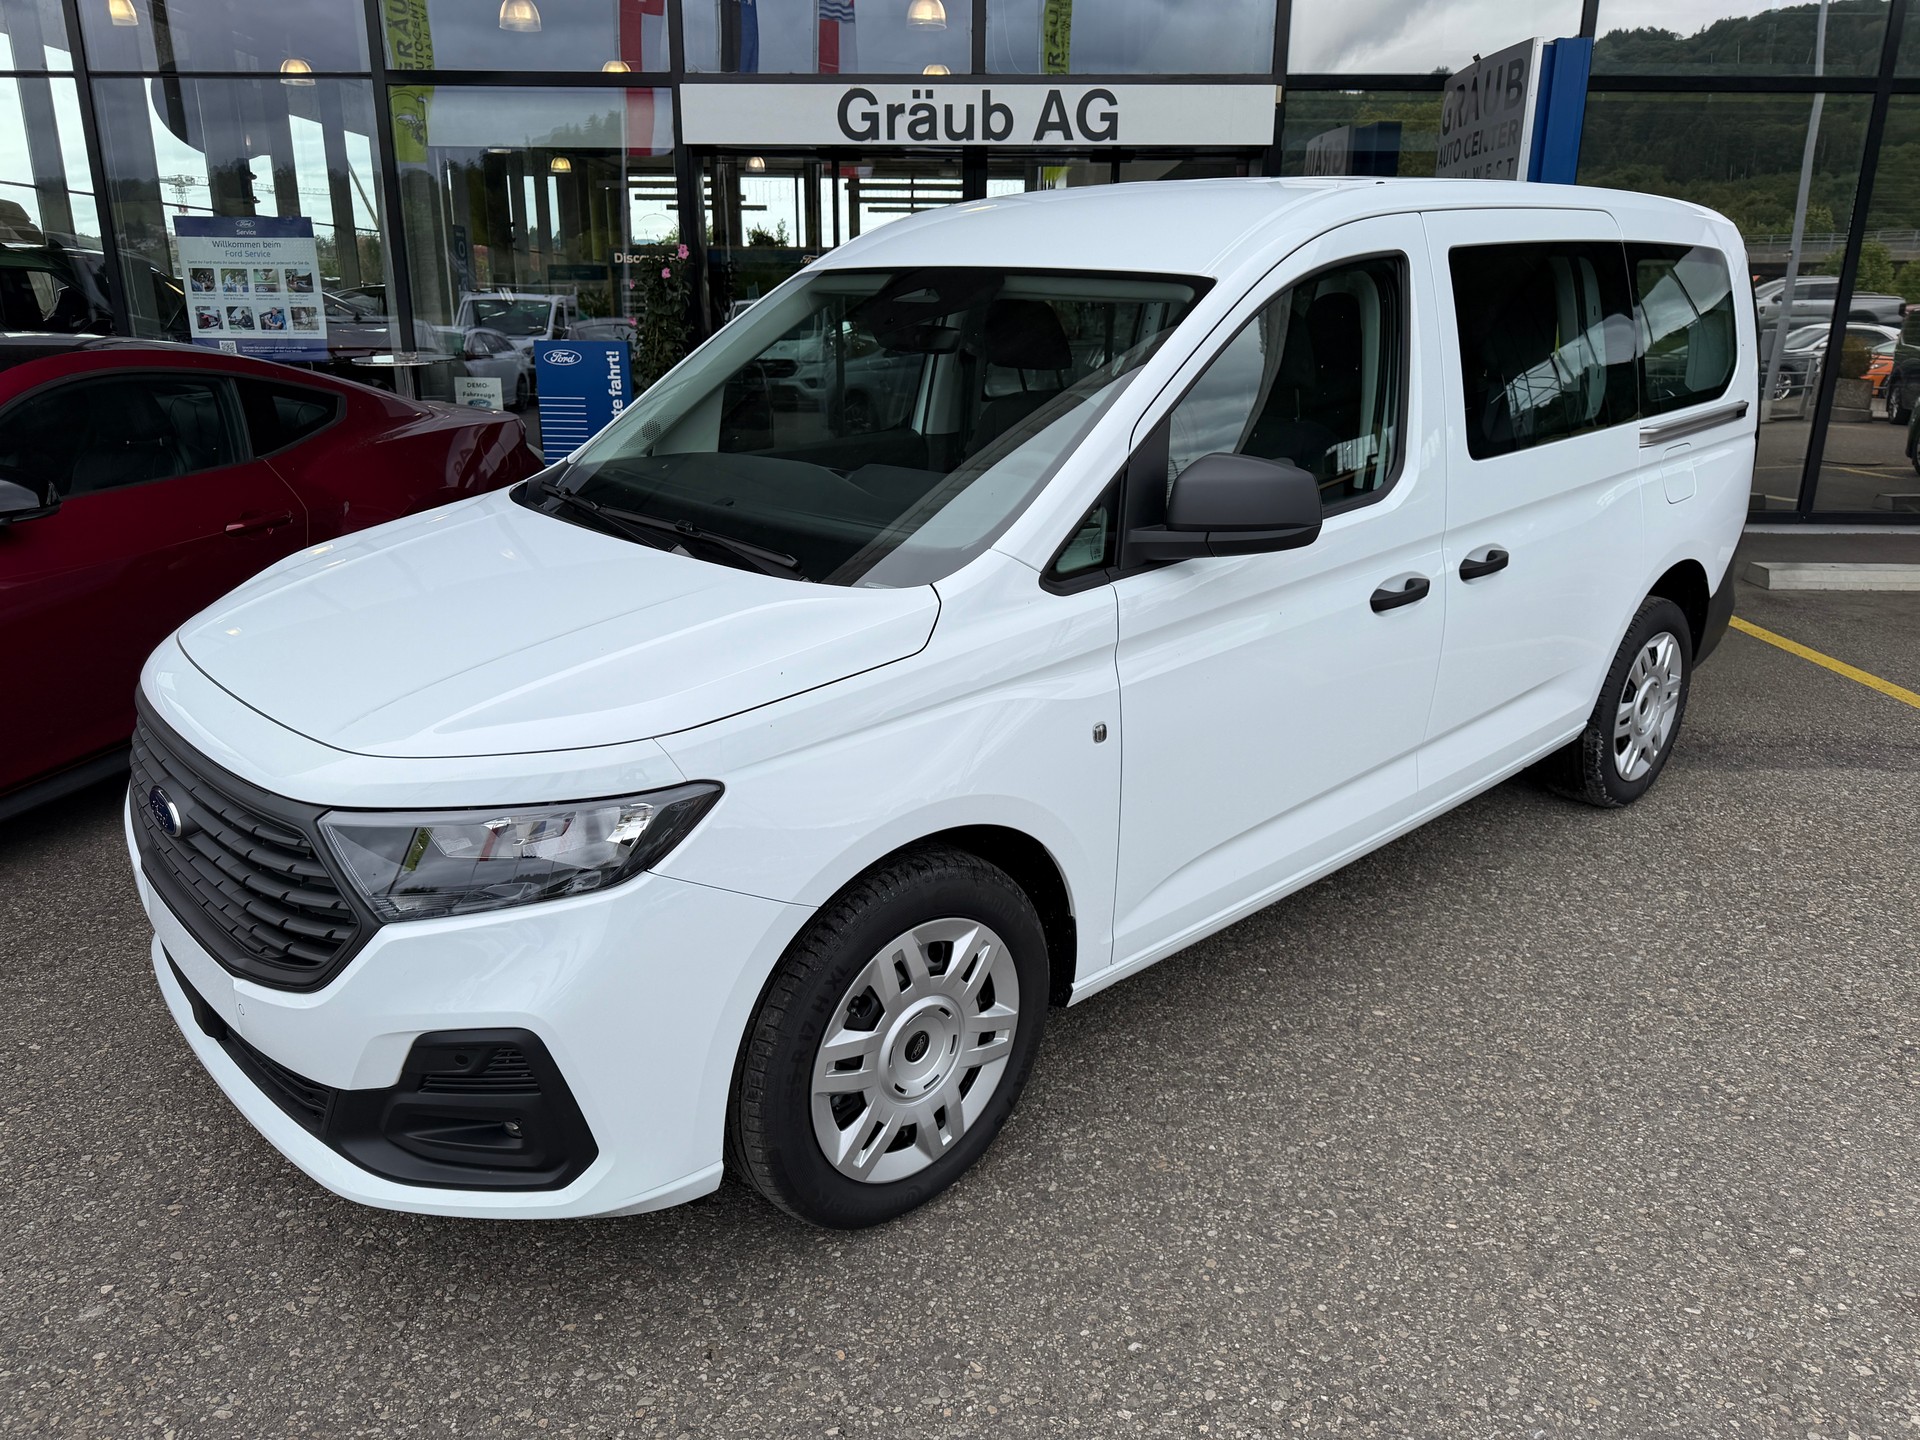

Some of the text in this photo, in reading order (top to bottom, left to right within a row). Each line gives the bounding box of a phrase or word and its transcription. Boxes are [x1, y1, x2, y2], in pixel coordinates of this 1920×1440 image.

[1441, 58, 1525, 136] GRÄUB
[837, 87, 1119, 141] Gräub AG
[1437, 133, 1460, 171] AUTO
[212, 240, 281, 249] Willkommen beim
[225, 250, 243, 258] Ford
[548, 351, 577, 365] Ford
[606, 351, 622, 397] fahrt!
[462, 391, 496, 399] Fahrzeuge
